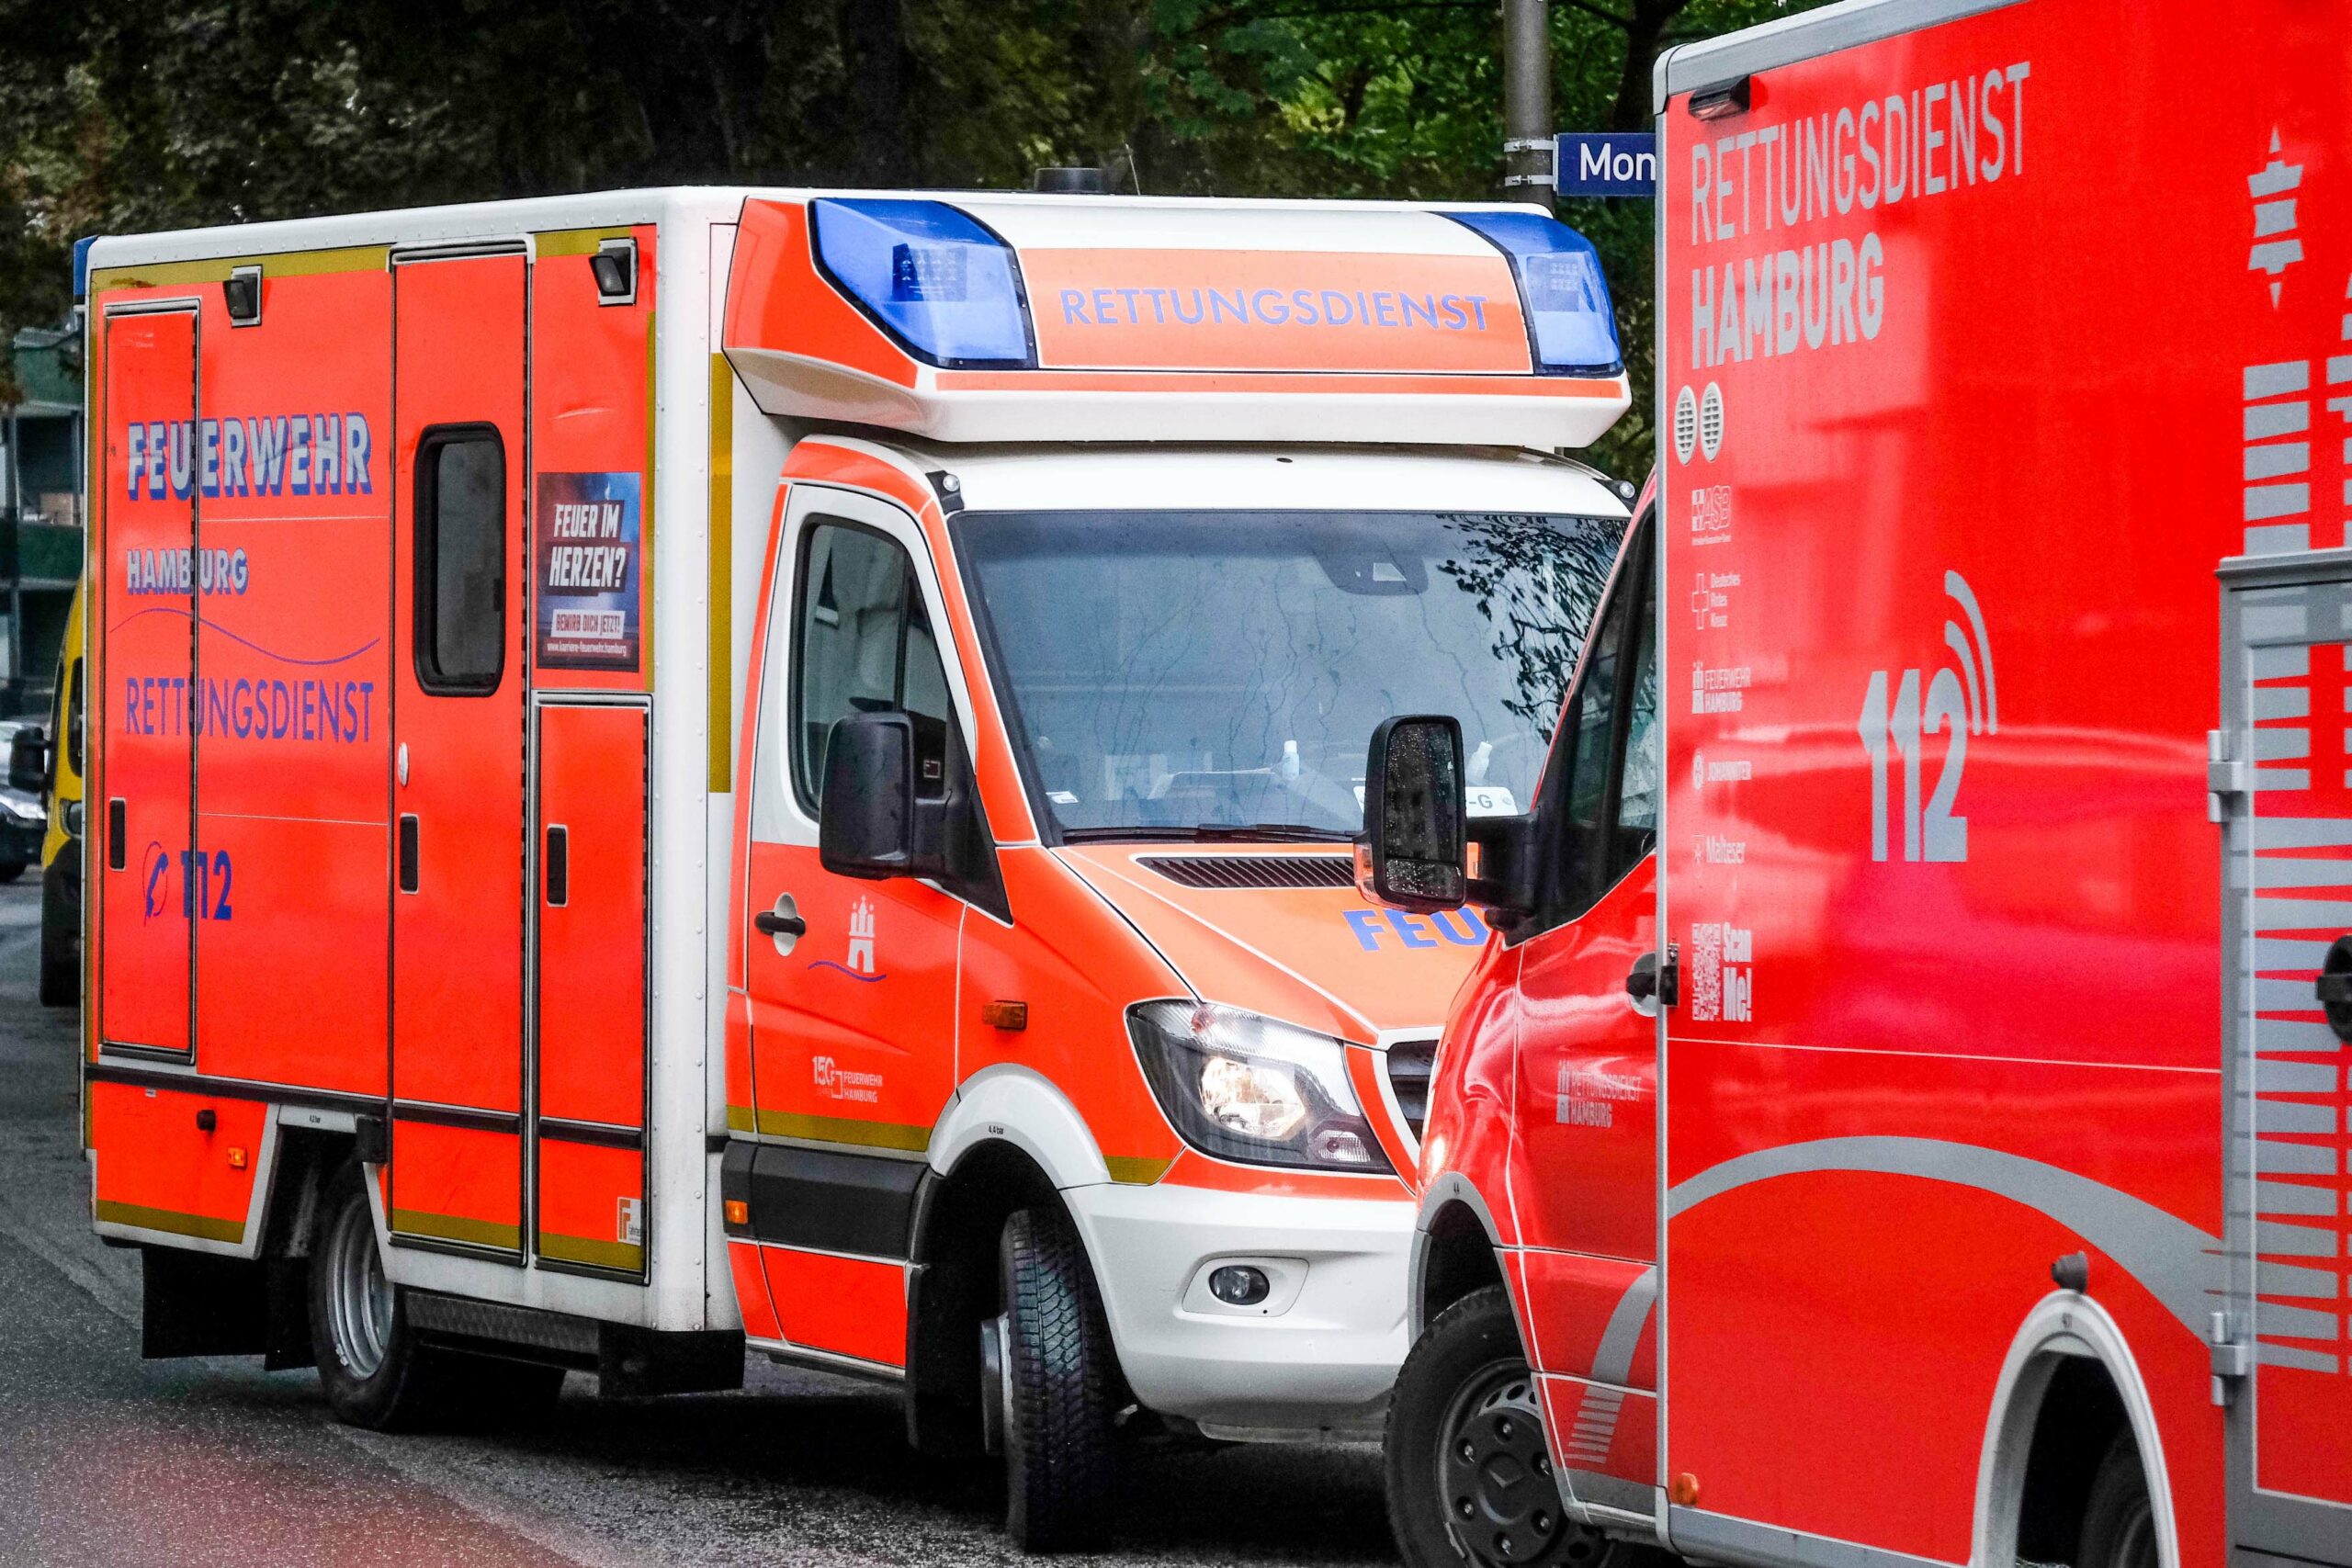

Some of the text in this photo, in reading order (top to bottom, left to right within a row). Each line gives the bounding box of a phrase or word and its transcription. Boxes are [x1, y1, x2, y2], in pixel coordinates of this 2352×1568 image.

[1580, 142, 1657, 181] Mon
[1691, 61, 2030, 246] RETTUNGSDIENST
[1060, 288, 1488, 332] RETTUNGSDIENST
[1691, 231, 1884, 369] HAMBURG
[126, 412, 373, 501] FEUERWEHR
[554, 503, 620, 538] FEUER IM
[126, 547, 248, 594] HAMBURG
[548, 547, 627, 588] HERZEN?
[556, 614, 581, 631] BEWIRB
[582, 615, 598, 632] DICH
[1705, 667, 1751, 690] FEUERWEHR
[126, 677, 374, 742] RETTUNGSDIENST
[1858, 668, 1967, 862] 112
[181, 850, 232, 920] 112
[843, 1071, 883, 1087] FEUERWEHR
[843, 1088, 877, 1103] HAMBURG
